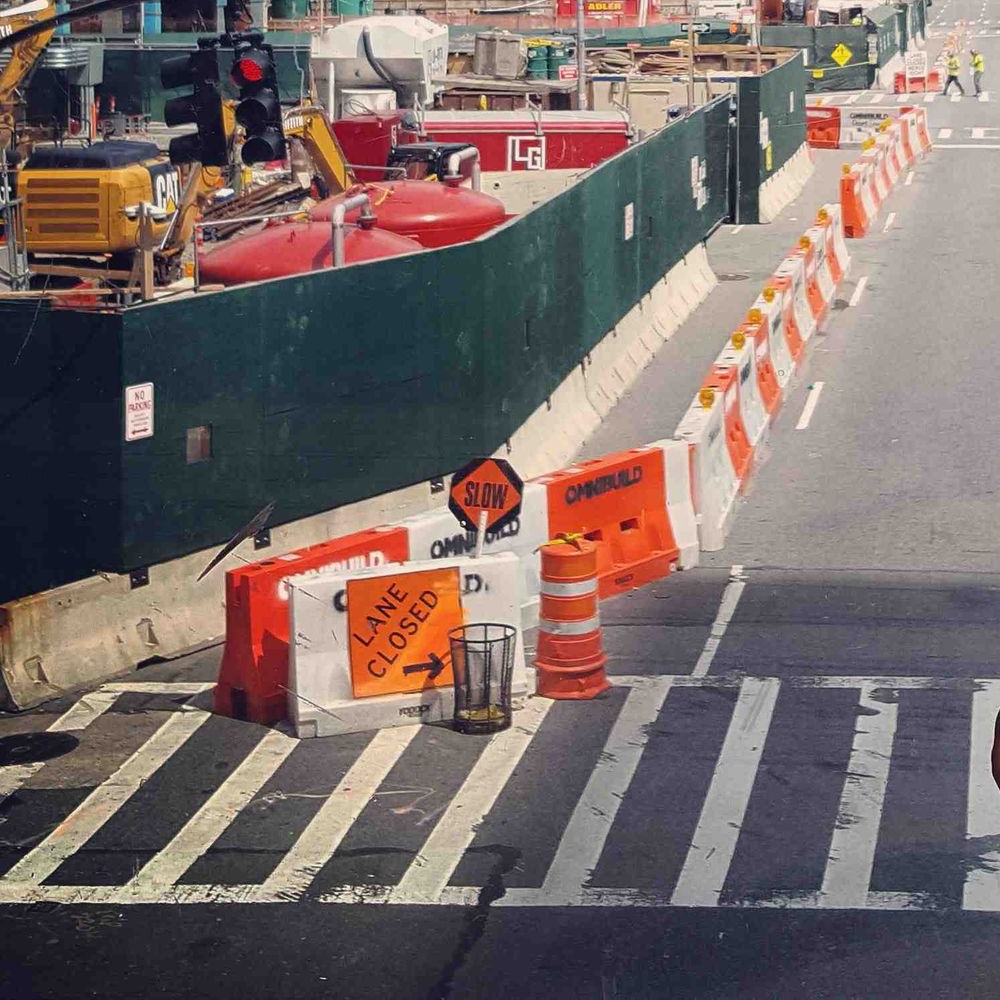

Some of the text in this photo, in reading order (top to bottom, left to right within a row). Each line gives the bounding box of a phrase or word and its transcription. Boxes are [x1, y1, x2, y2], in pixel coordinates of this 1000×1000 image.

[588, 2, 622, 11] ADLER
[156, 171, 179, 210] CAT
[134, 390, 145, 400] NO
[464, 481, 509, 509] SLOW
[565, 466, 643, 505] OMNIBUILD
[430, 517, 520, 560] OMNIUILD
[353, 583, 408, 647] LANE
[367, 590, 438, 679] CLOSED
